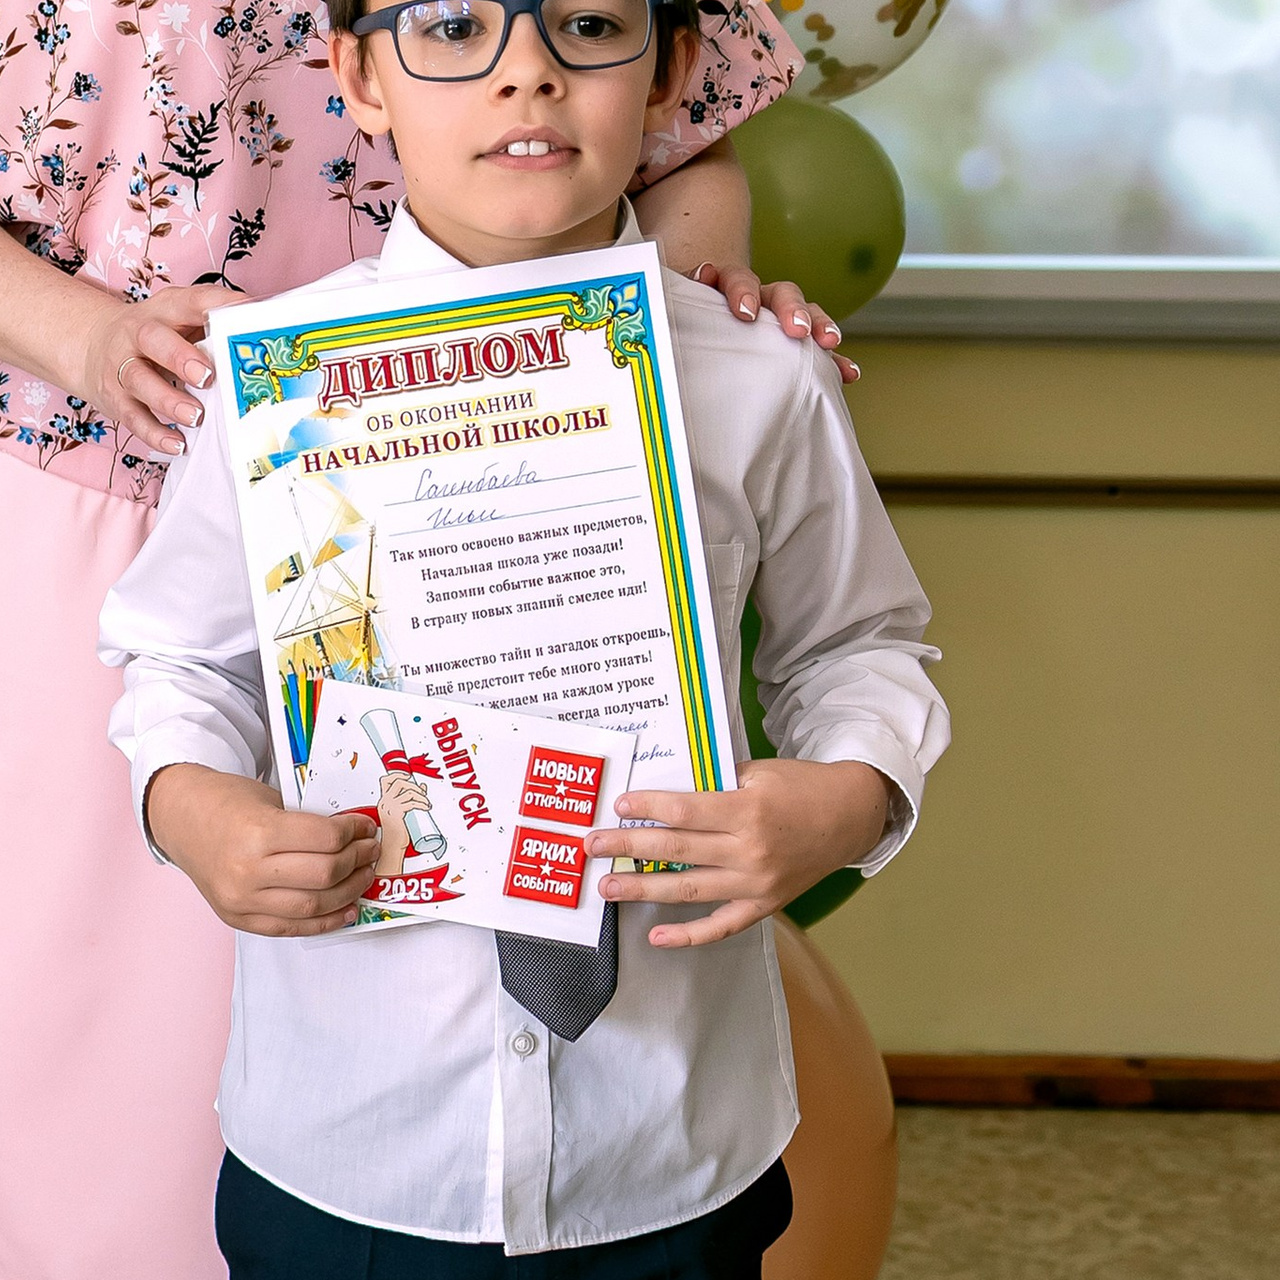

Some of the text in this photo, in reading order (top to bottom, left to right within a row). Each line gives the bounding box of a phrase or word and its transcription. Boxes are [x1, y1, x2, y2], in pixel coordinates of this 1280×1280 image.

[320, 327, 567, 405] ДИПЛОМ
[367, 391, 535, 432] ОБ ОКОНЧАНИИ
[302, 407, 609, 474] НАЧАЛЬНОЙ ШКОЛЫ
[390, 514, 647, 562] Так много освоено важных предметов,
[421, 538, 624, 581] Начальная школа уже позади!
[426, 564, 626, 603] Запомни событие важное это,
[411, 580, 648, 629] В страну новых знаний смелее иди!
[400, 628, 670, 677] Ты множество тайн и загадок откроешь,
[426, 650, 653, 697] Ещё предстоит тебе много узнать!
[488, 694, 539, 709] желаем
[542, 690, 558, 702] на
[562, 682, 613, 700] каждом
[617, 675, 655, 693] уроке
[558, 694, 669, 722] всегда получать!
[431, 717, 492, 830] ВЫПУСК
[532, 758, 596, 786] НОВЫХ
[524, 791, 593, 815] ОТКРЫТИЙ
[520, 838, 578, 865] ЯРКИХ
[377, 877, 435, 902] 2025
[513, 872, 574, 897] СОБЫТИЙ
